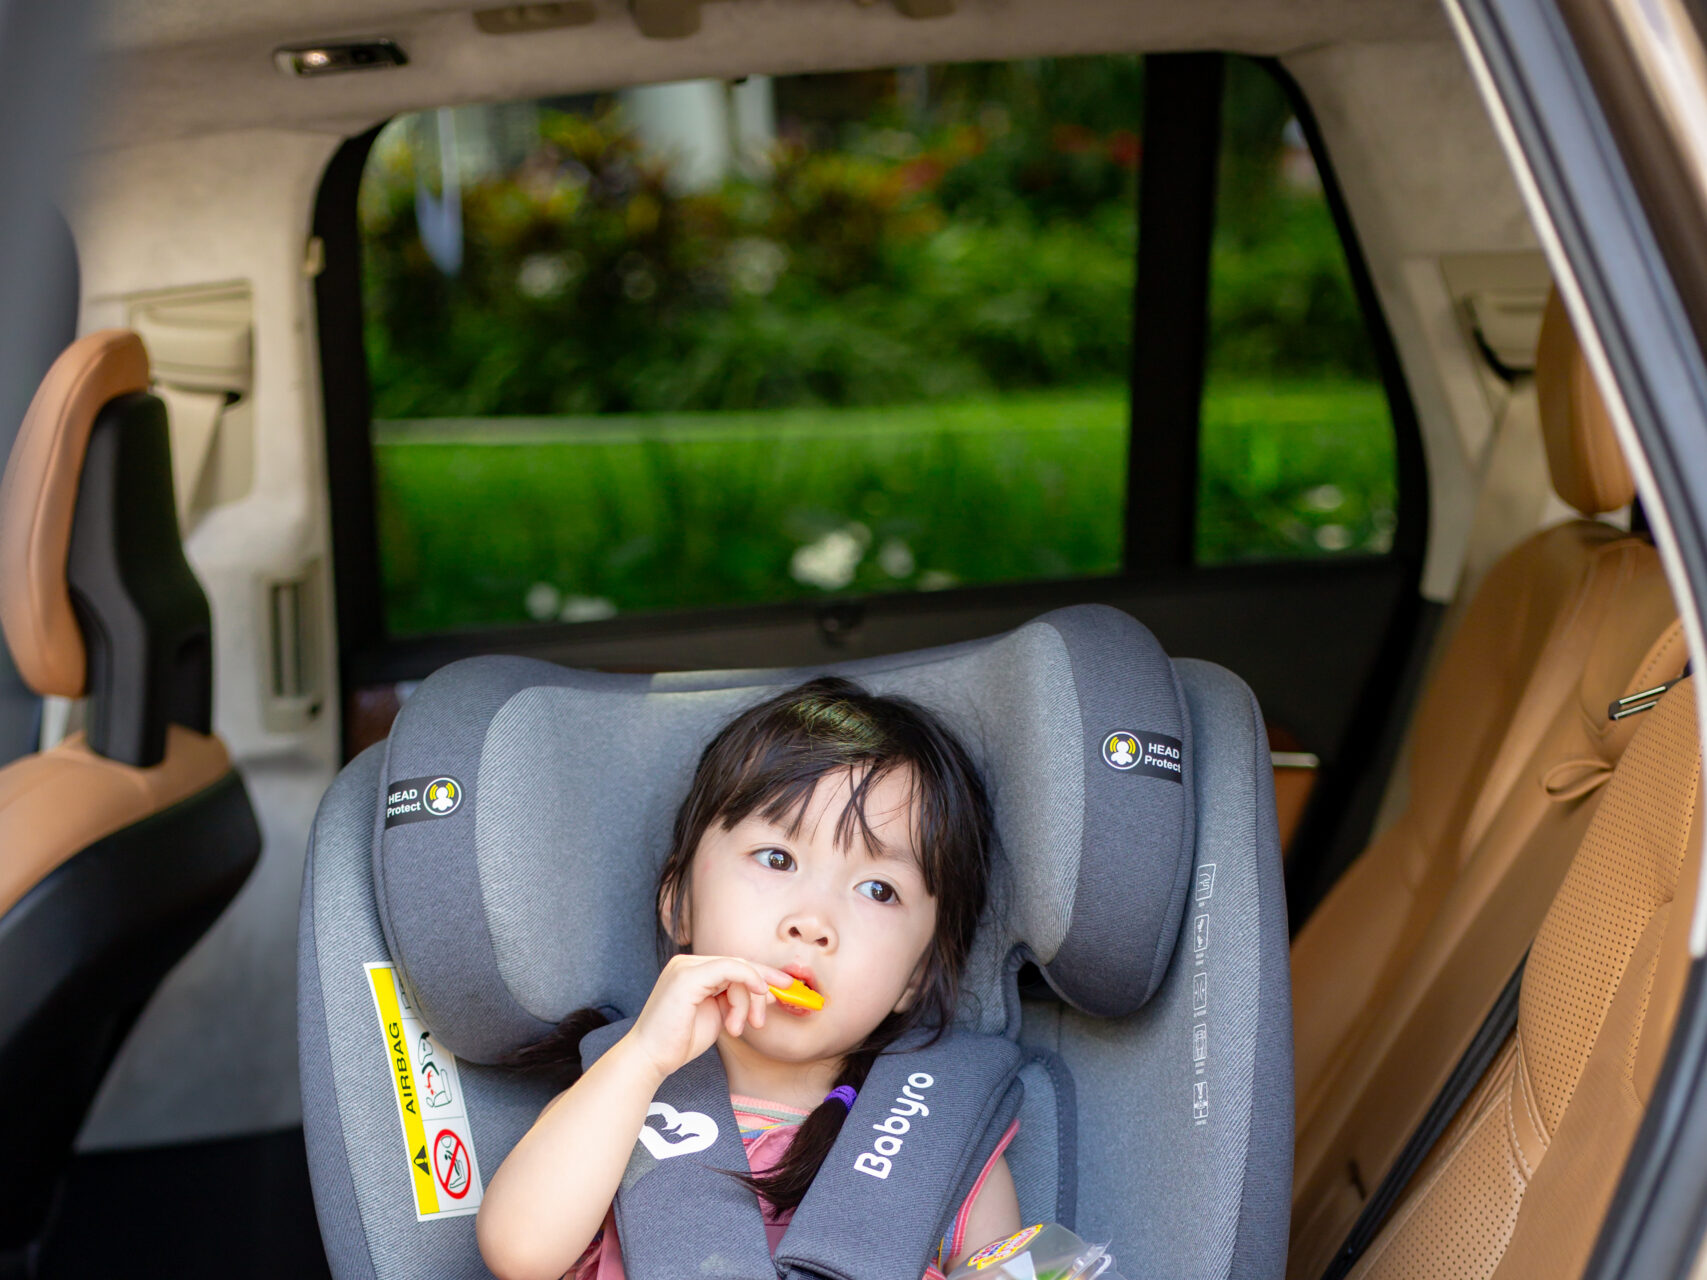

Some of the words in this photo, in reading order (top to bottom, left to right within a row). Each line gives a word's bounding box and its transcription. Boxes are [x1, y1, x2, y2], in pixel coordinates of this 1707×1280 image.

[1149, 743, 1180, 759] HEAD
[1144, 755, 1181, 773] Protect
[388, 789, 418, 805] HEAD
[387, 802, 421, 818] Protect
[389, 1022, 416, 1115] AIRBAG
[854, 1073, 934, 1179] Babyro
